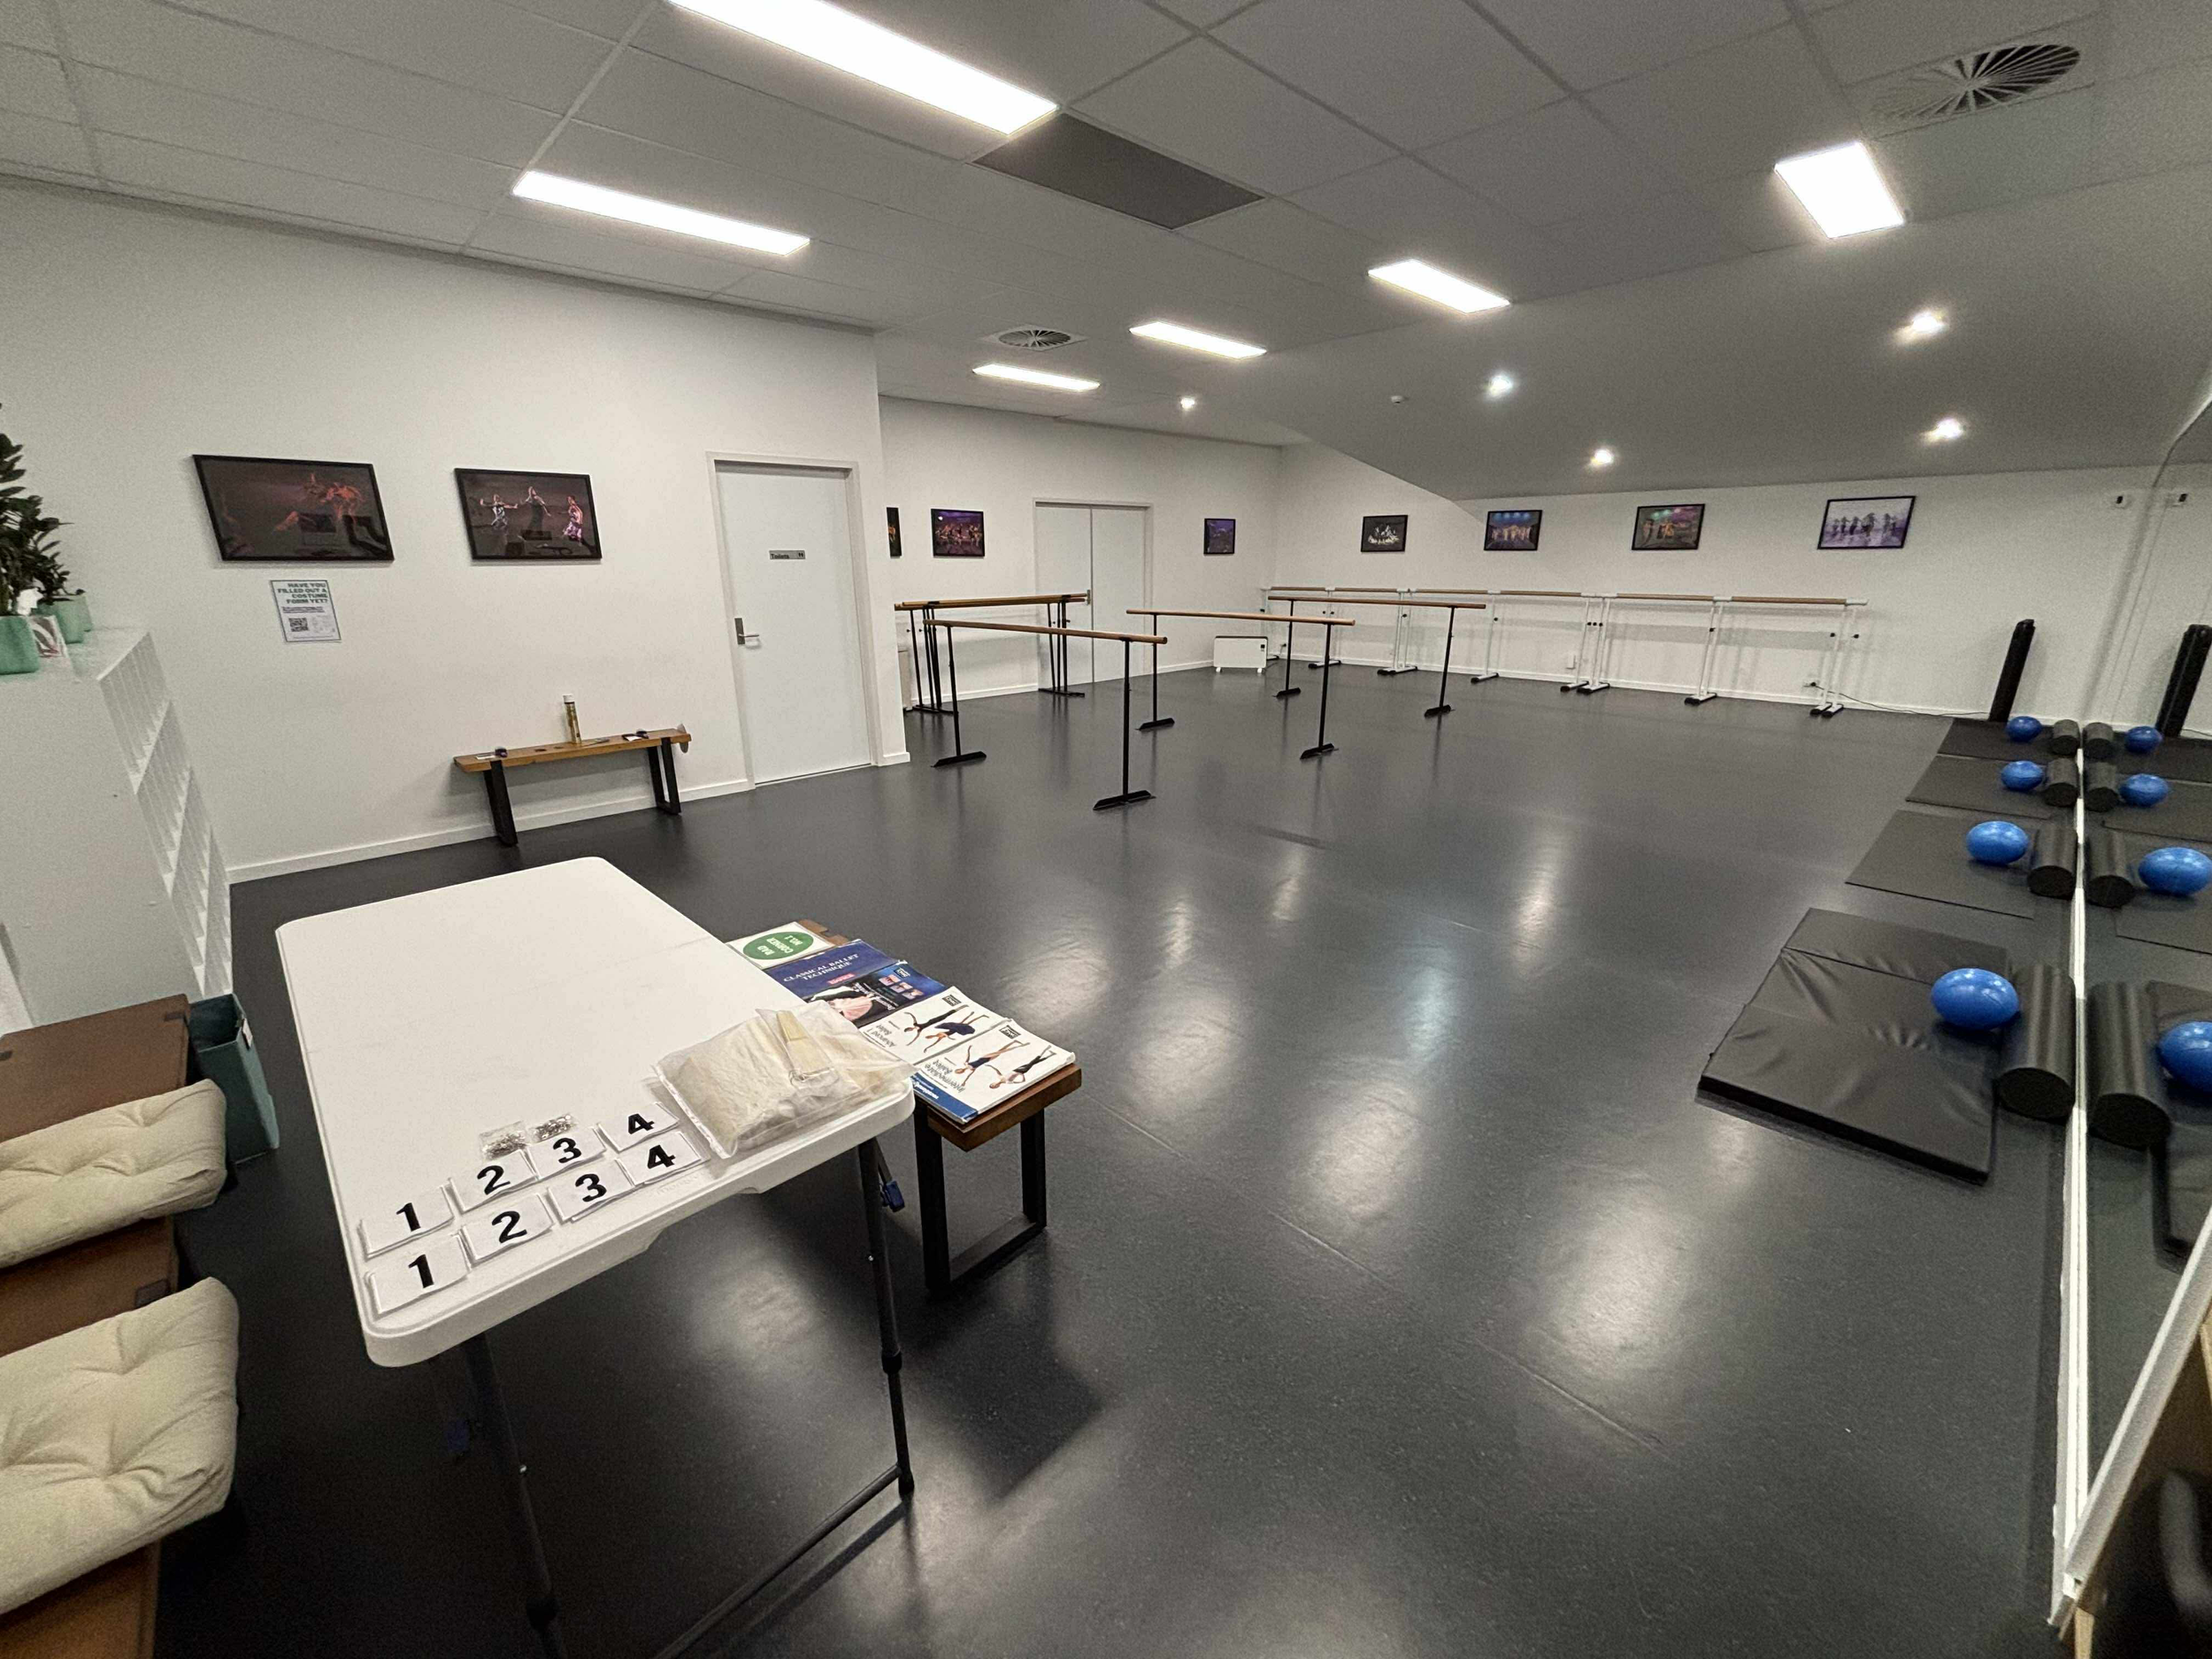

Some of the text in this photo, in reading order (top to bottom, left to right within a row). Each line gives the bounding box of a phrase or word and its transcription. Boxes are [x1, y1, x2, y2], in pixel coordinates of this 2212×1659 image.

[757, 945, 776, 956] RAD
[766, 938, 794, 954] CORNER
[783, 964, 828, 982] CLASSICAL
[828, 953, 859, 966] BALLET
[802, 961, 853, 980] TECHNIQUE
[871, 1031, 895, 1048] Advanced
[875, 1024, 892, 1035] Ballet
[925, 1064, 965, 1093] Intermediate
[932, 1060, 953, 1074] Ballet
[628, 1114, 654, 1134] 4
[553, 1138, 581, 1163] 3
[648, 1145, 675, 1169] 4
[477, 1165, 510, 1194] 2
[575, 1174, 606, 1202] 3
[396, 1203, 420, 1232] 1
[492, 1211, 526, 1243] 2
[409, 1255, 434, 1288] 1
